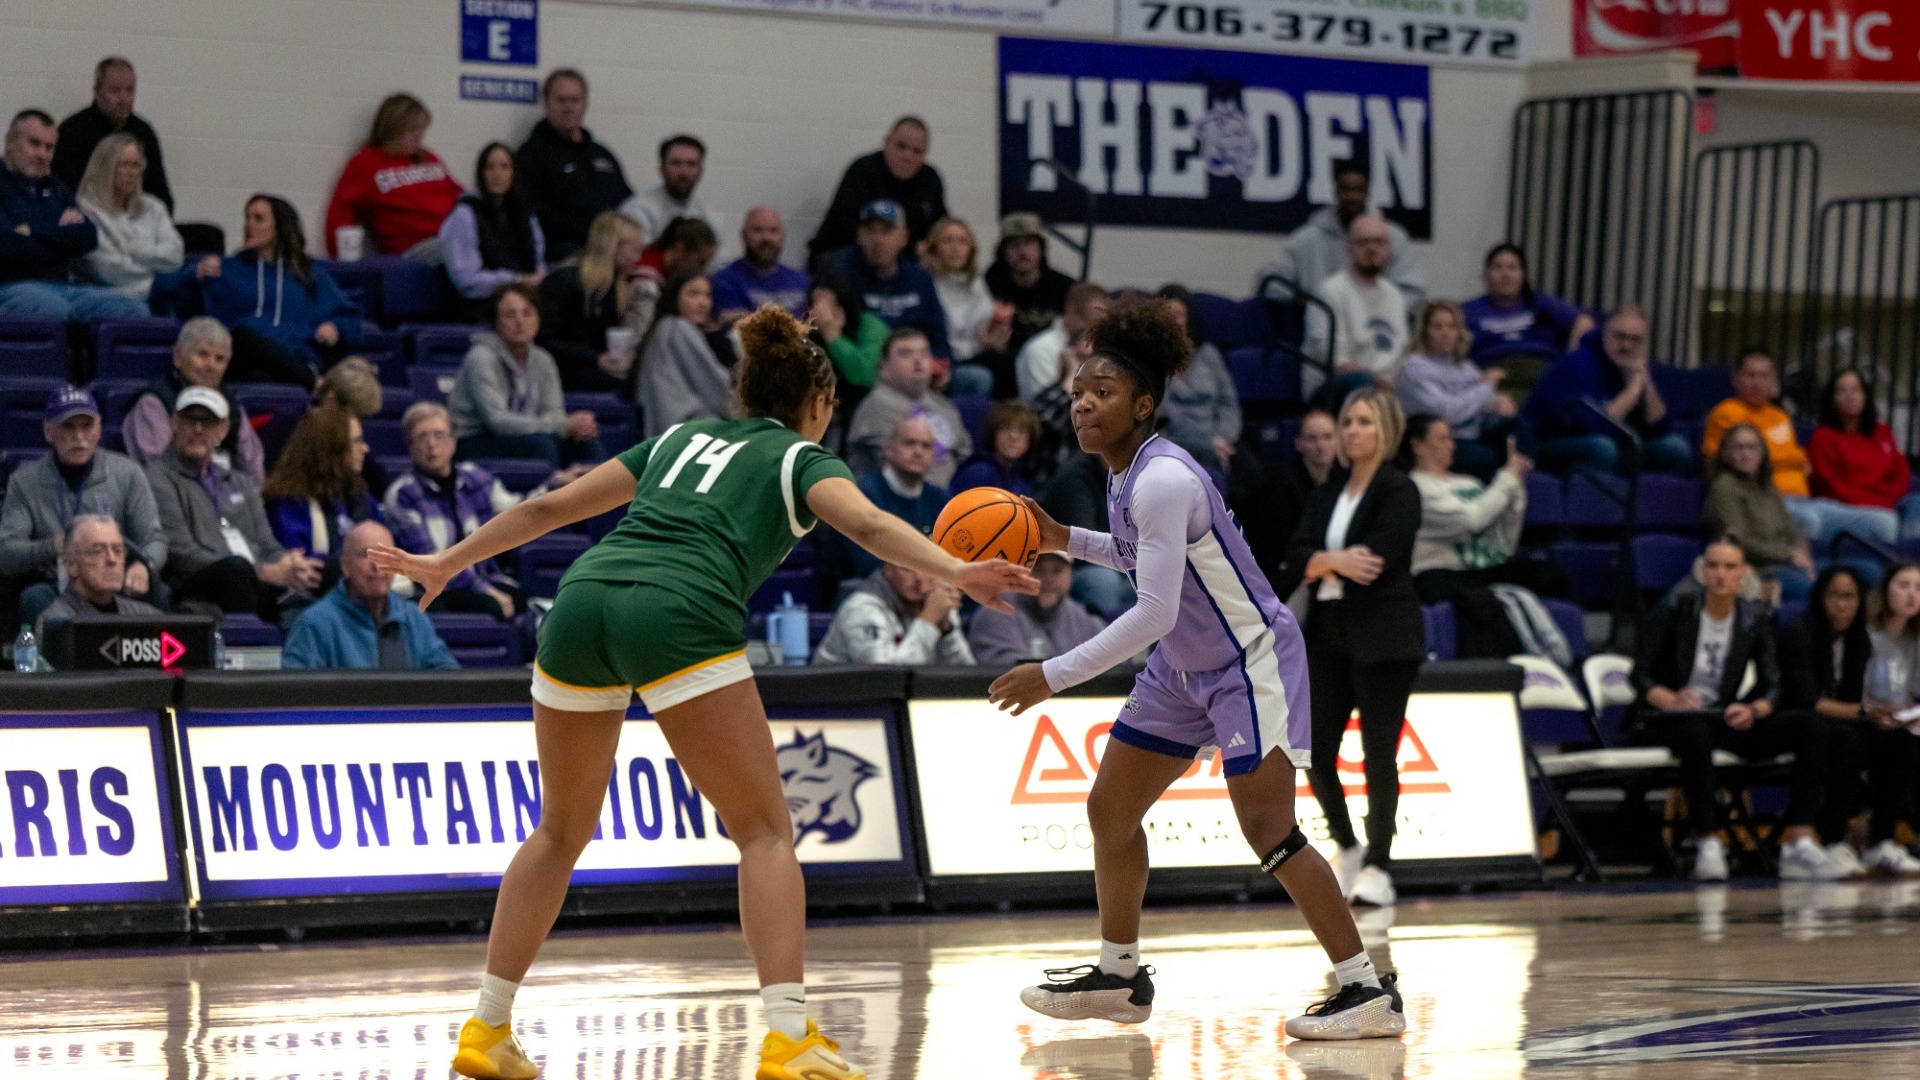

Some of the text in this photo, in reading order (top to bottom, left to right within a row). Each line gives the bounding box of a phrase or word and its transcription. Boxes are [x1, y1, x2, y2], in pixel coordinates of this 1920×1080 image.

[487, 20, 512, 60] E
[1141, 2, 1519, 60] 706-379-1272
[1764, 8, 1894, 61] YHC
[1006, 72, 1209, 200] THE
[658, 432, 750, 495] 14
[121, 637, 161, 662] POSS
[0, 765, 135, 858] RIS
[202, 757, 543, 853] MOUNTAIN
[1020, 822, 1095, 851] POO
